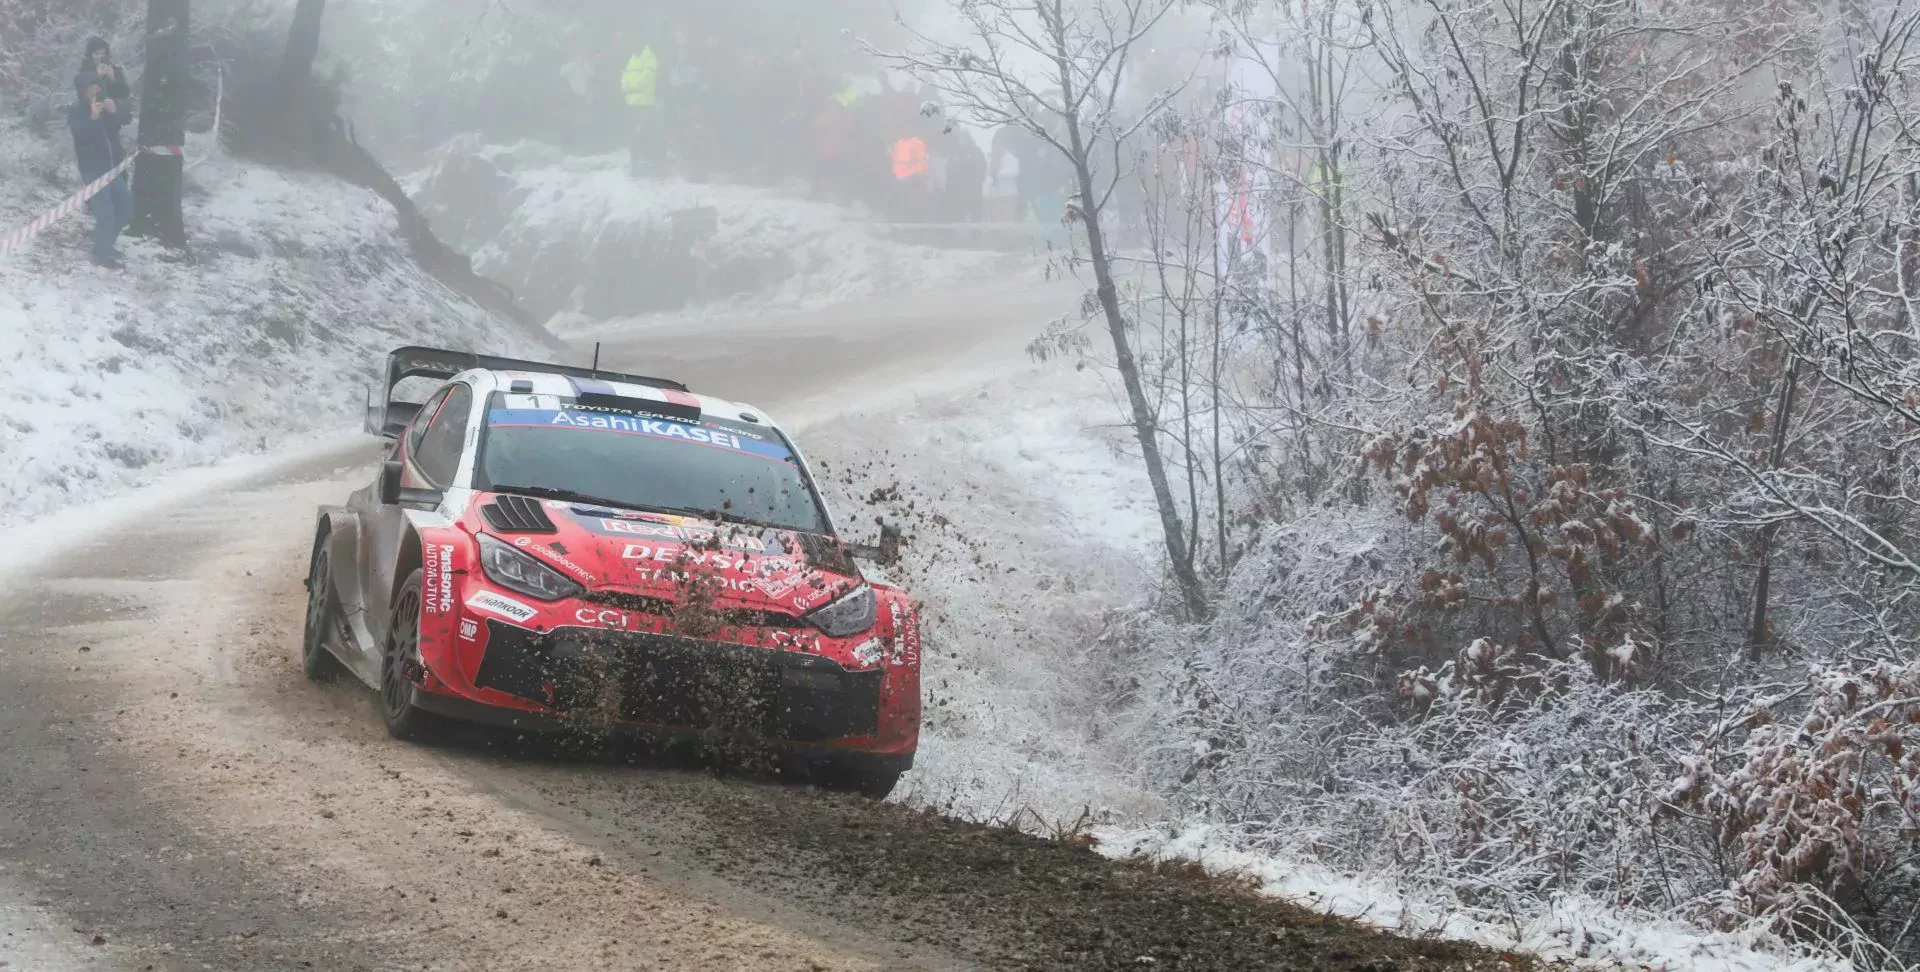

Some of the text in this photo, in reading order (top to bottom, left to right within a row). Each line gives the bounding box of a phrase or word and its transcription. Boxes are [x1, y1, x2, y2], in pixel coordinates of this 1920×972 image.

[526, 395, 540, 408] 1
[560, 403, 762, 440] TOYOTA GAZOO Racing
[621, 544, 757, 574] DENSO
[426, 543, 437, 613] AUTOMOTIVE
[440, 543, 454, 612] Panasonic
[460, 620, 477, 638] OMP
